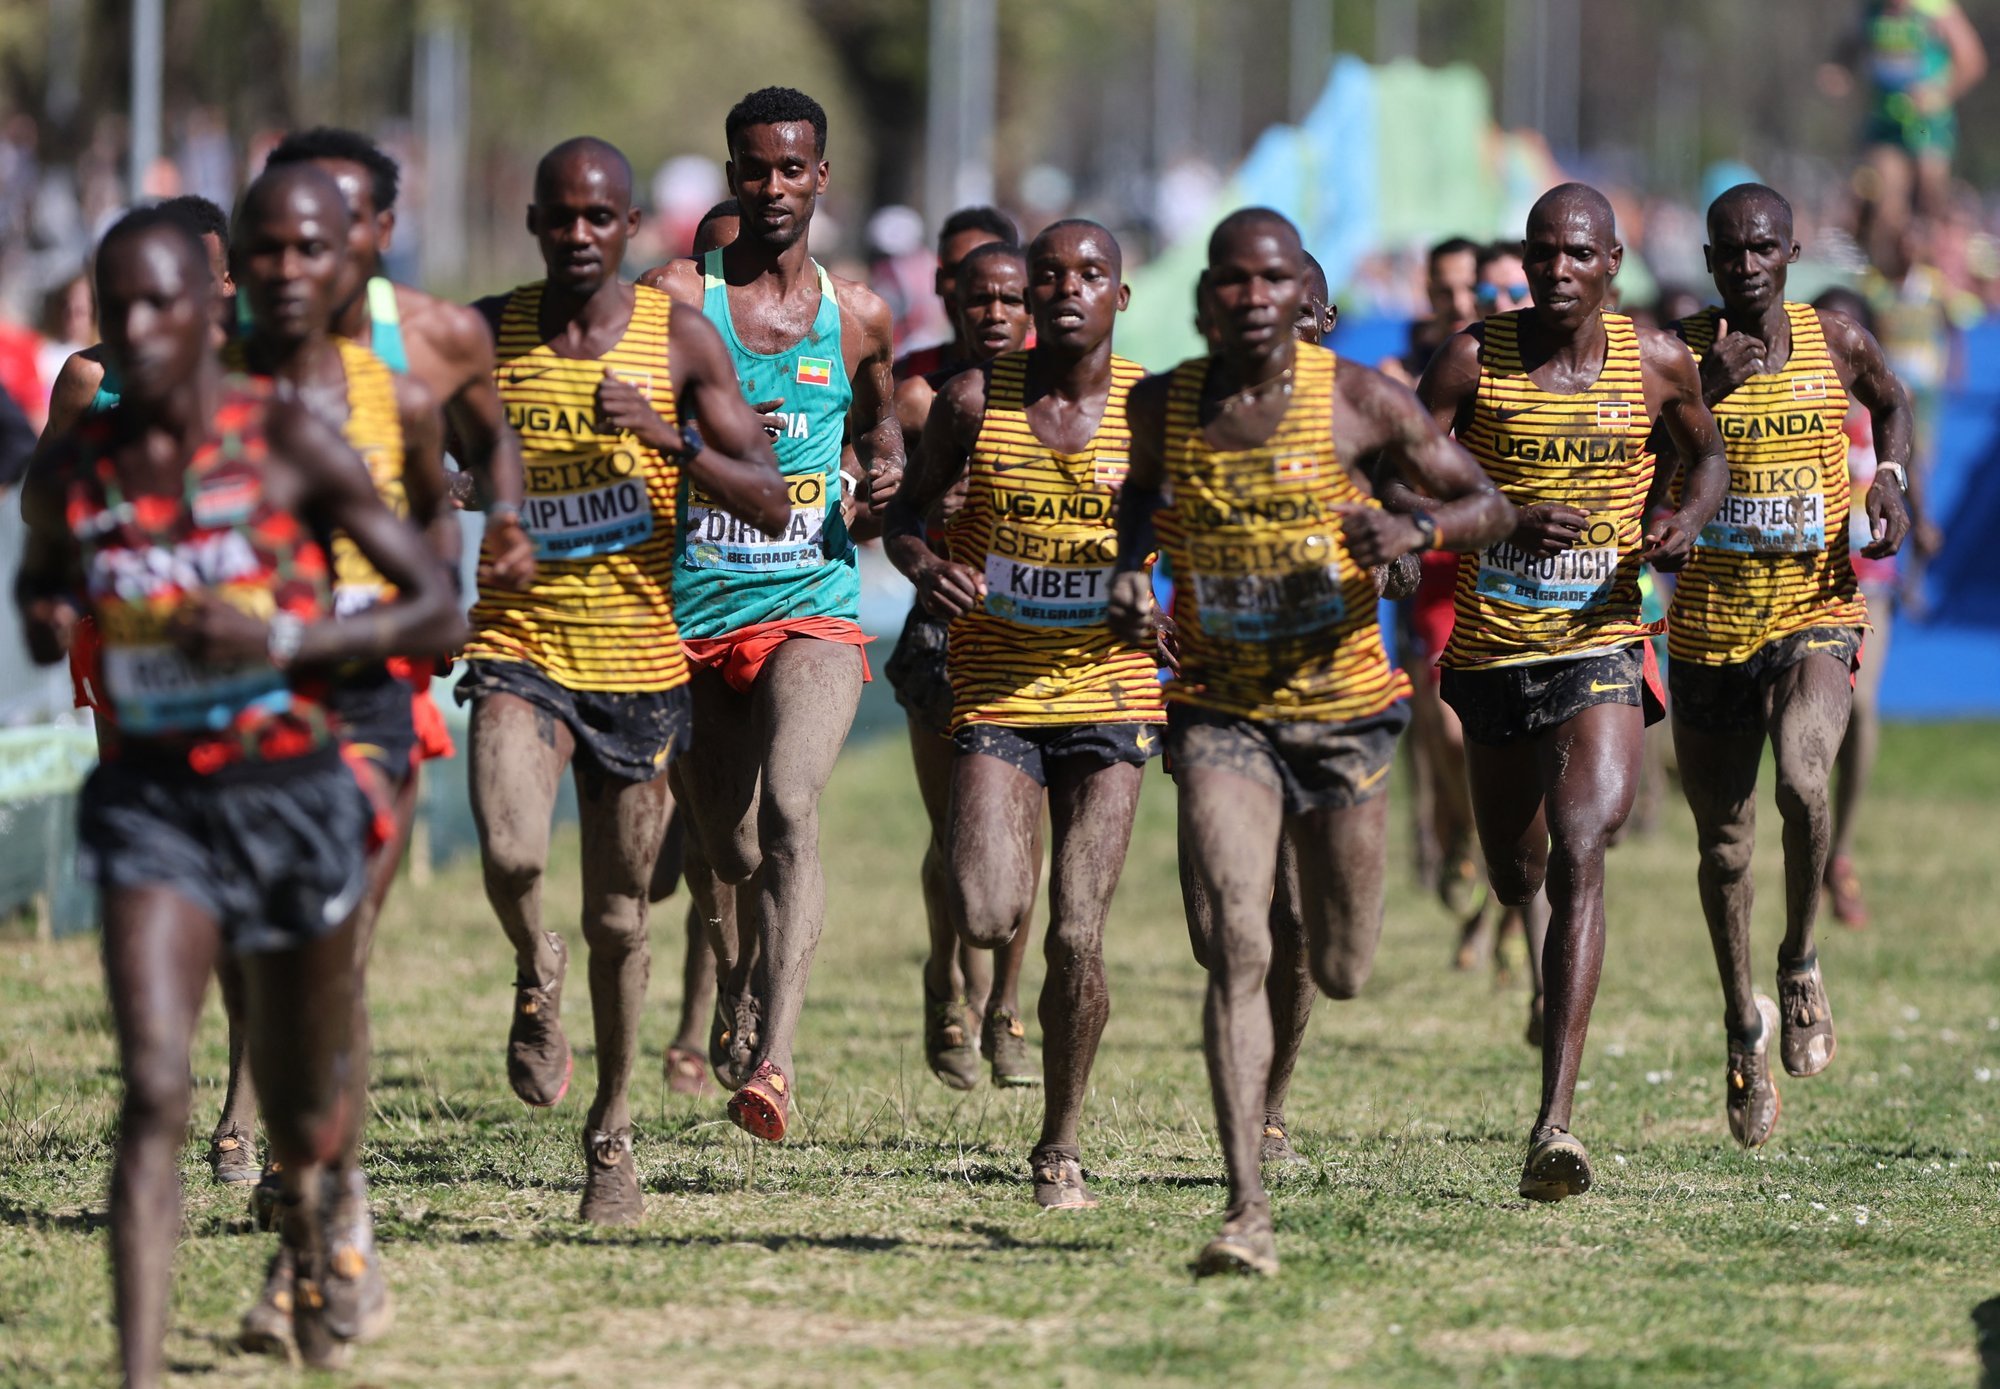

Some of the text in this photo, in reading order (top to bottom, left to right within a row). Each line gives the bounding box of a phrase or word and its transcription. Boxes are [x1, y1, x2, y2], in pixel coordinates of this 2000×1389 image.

[1493, 434, 1626, 462] UGANDA
[522, 450, 636, 492] EIKO
[1729, 466, 1817, 493] EIKO
[521, 483, 638, 529] IPLIMO
[992, 491, 1109, 520] UGAND
[727, 548, 818, 564] BELGRADE 24
[995, 526, 1118, 564] SEIKO
[1010, 563, 1102, 598] KIBET
[1515, 584, 1588, 601] BELGRADE
[1021, 606, 1097, 620] BELGRADE
